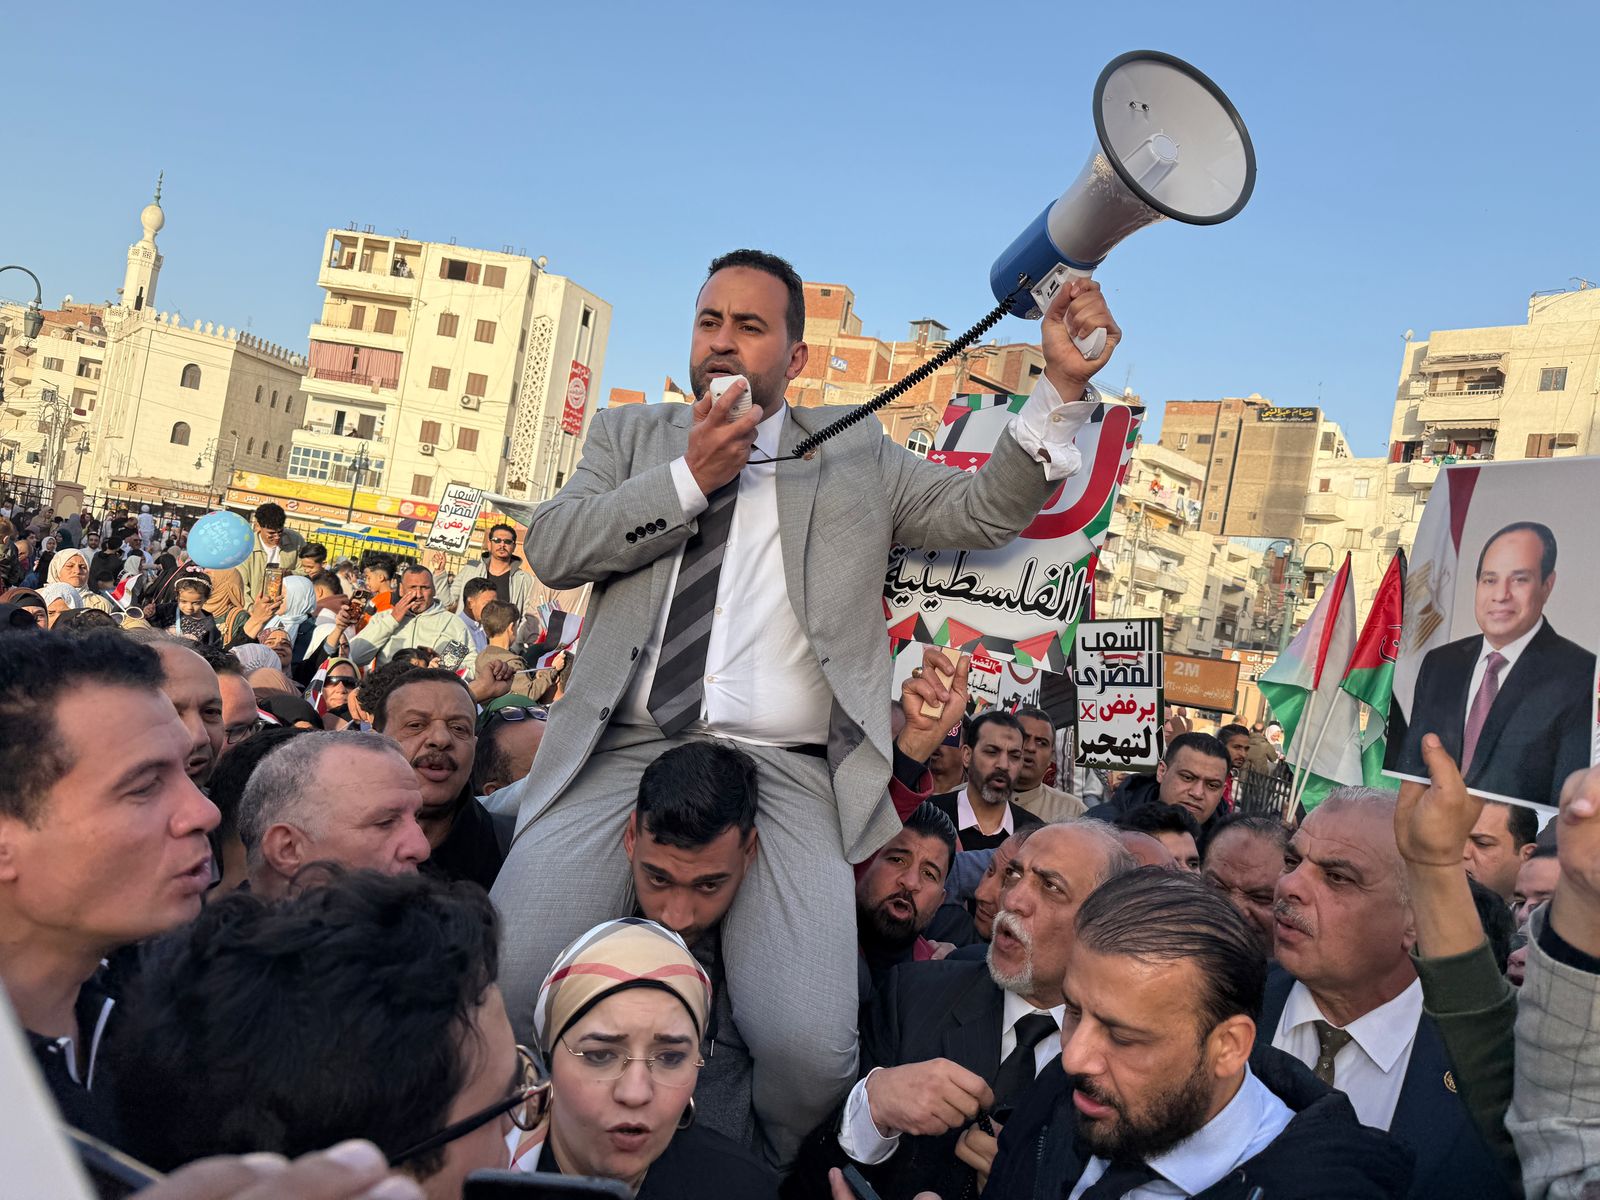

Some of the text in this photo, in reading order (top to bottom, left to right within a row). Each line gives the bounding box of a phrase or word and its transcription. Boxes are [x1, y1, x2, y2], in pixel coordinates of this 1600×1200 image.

[443, 519, 471, 534] يرفض
[1081, 620, 1153, 658] الشعب
[1099, 693, 1156, 724] يرفض
[1075, 725, 1165, 766] التهجير
